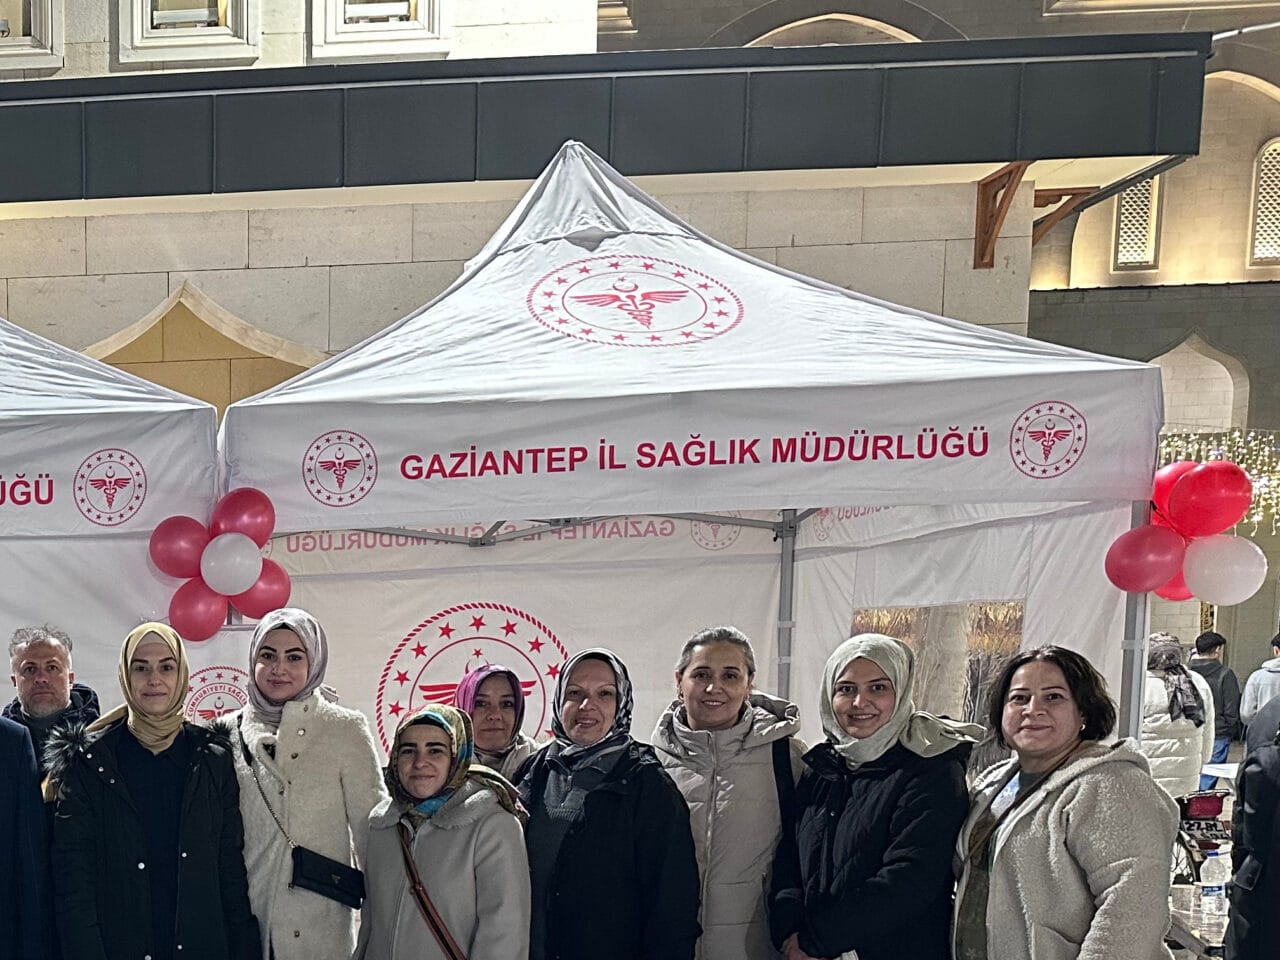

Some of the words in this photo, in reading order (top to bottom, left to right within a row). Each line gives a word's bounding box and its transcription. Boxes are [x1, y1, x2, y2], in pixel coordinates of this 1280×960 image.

[400, 446, 588, 479] GAZİANTEP
[599, 439, 626, 469] İL
[636, 434, 761, 468] SAĞLIK
[772, 426, 989, 463] MÜDÜRLÜĞÜ
